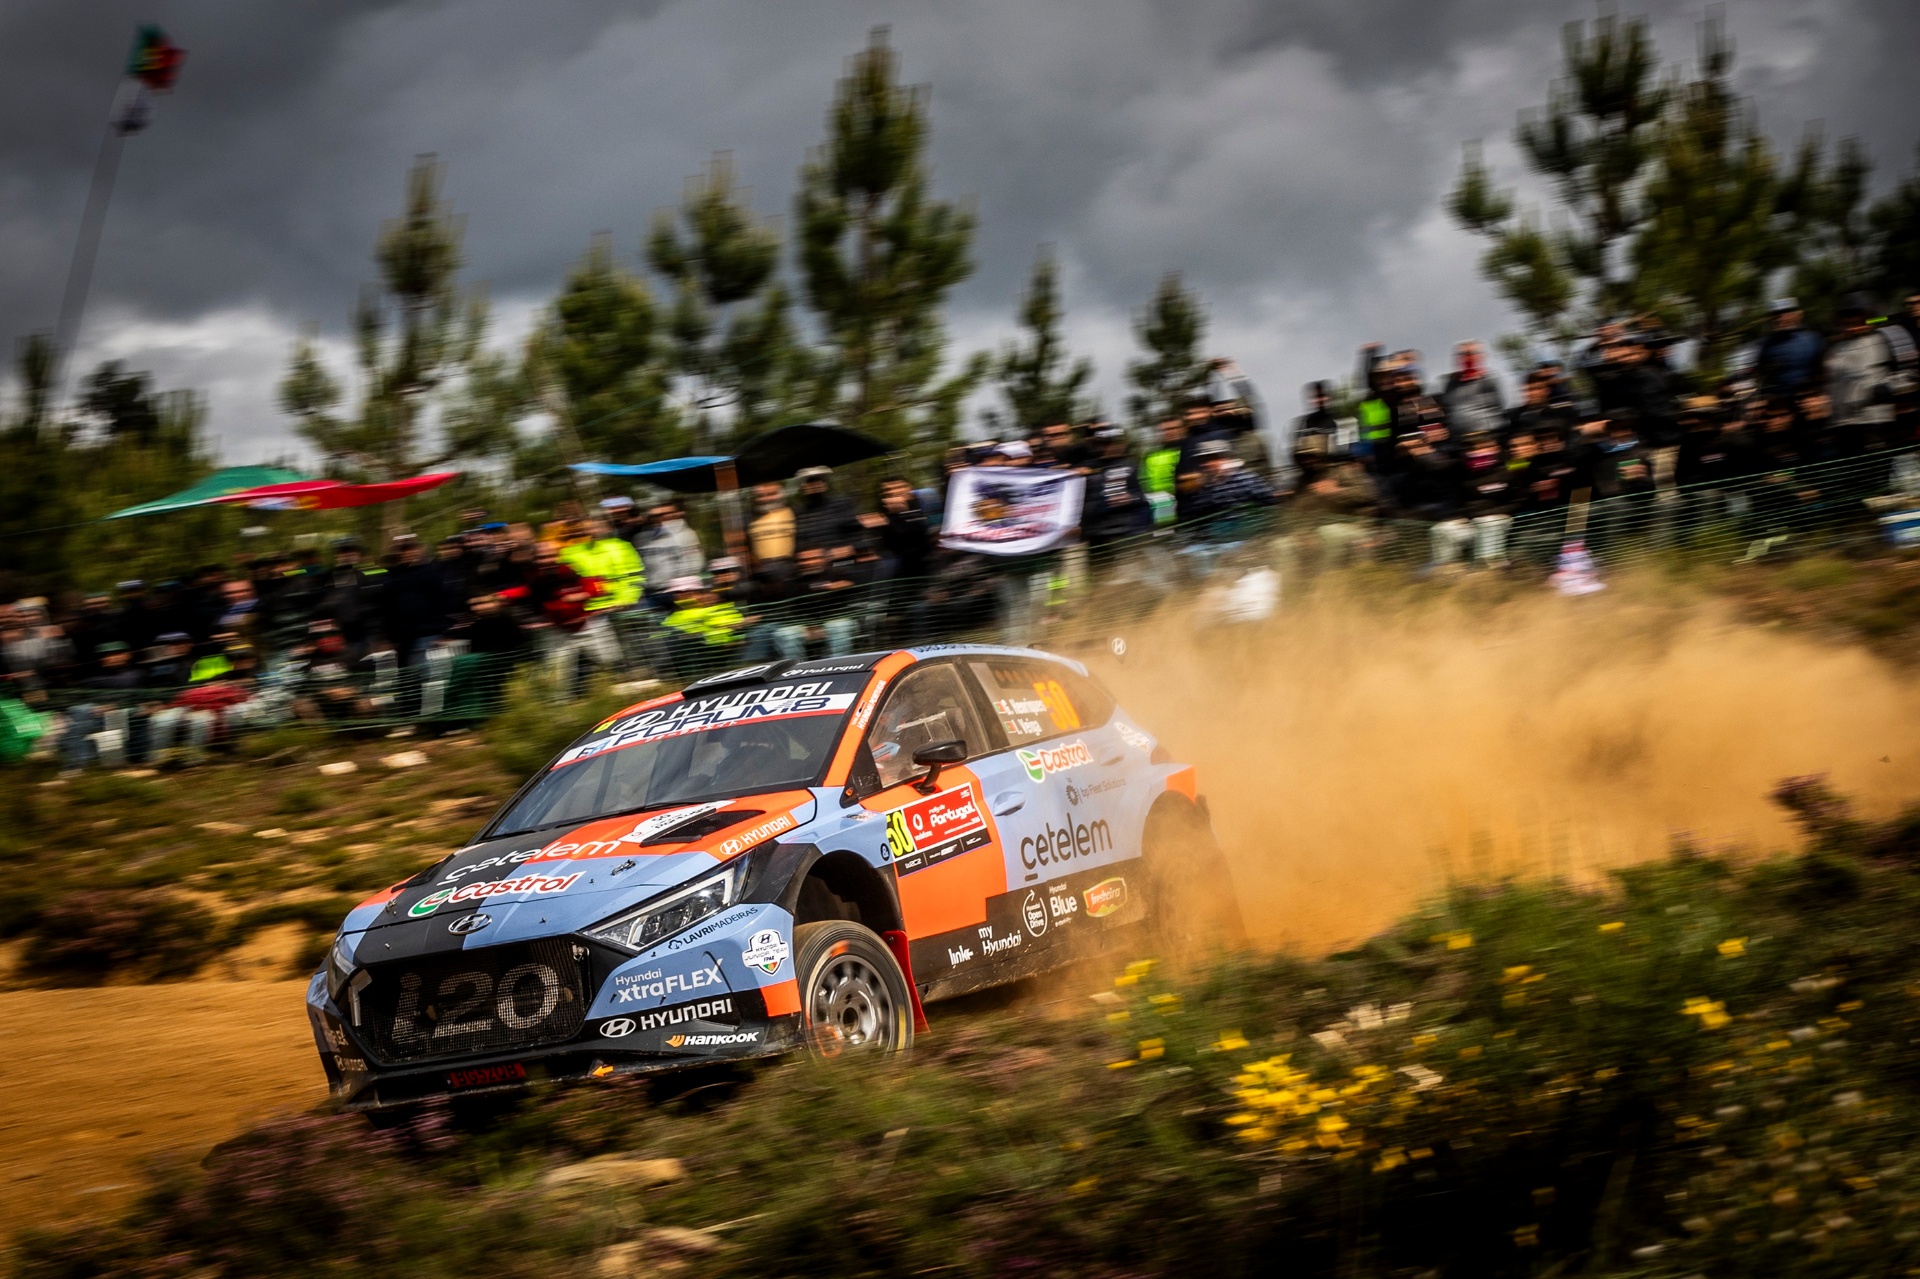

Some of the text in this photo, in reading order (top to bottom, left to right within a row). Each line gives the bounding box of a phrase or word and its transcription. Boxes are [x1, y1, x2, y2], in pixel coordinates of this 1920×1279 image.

[668, 681, 833, 720] HYUNDAI
[1034, 680, 1080, 730] 50
[613, 697, 831, 746] FORUM8
[1040, 741, 1093, 771] Castrol
[930, 801, 976, 828] Portugal
[741, 816, 792, 845] HYUNDAI
[885, 811, 914, 857] 50
[1020, 813, 1113, 881] cetelem
[437, 840, 621, 886] cetelem
[452, 871, 581, 901] Castrol
[1049, 882, 1066, 894] Hyundai
[1027, 911, 1042, 921] Open
[1050, 895, 1077, 917] Blue
[978, 926, 992, 939] my
[1030, 919, 1044, 929] Drive
[982, 930, 1021, 957] Hyundai
[615, 968, 662, 986] Hyundai
[617, 958, 724, 1003] xtraFLEX
[392, 962, 560, 1045] i20
[640, 998, 733, 1031] HYUNDAI
